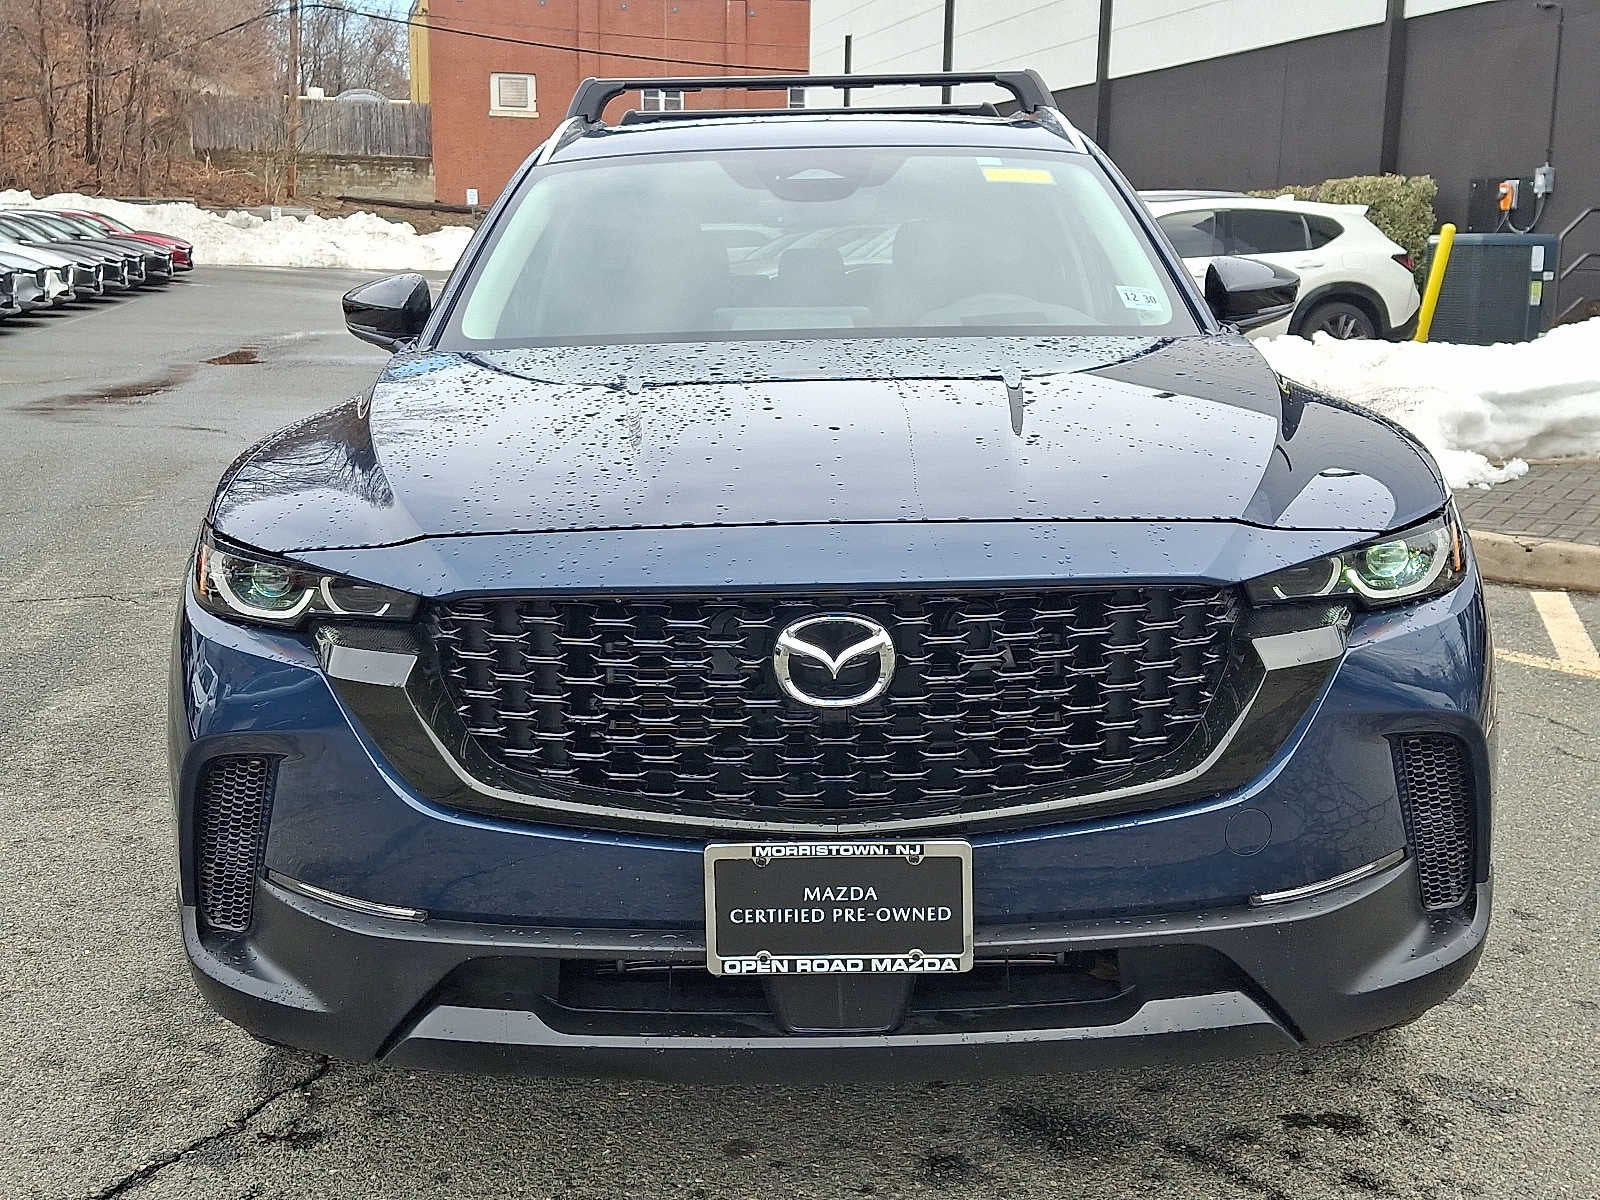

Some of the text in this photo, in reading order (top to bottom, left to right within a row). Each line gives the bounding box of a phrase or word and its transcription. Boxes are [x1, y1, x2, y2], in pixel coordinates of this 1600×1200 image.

[755, 844, 921, 857] MORRISTOWN, NJ
[803, 886, 878, 901] MAZDA
[729, 907, 952, 923] CERTIFIED PRE-OWNED
[723, 958, 958, 973] OPEN ROAD MAZDA
